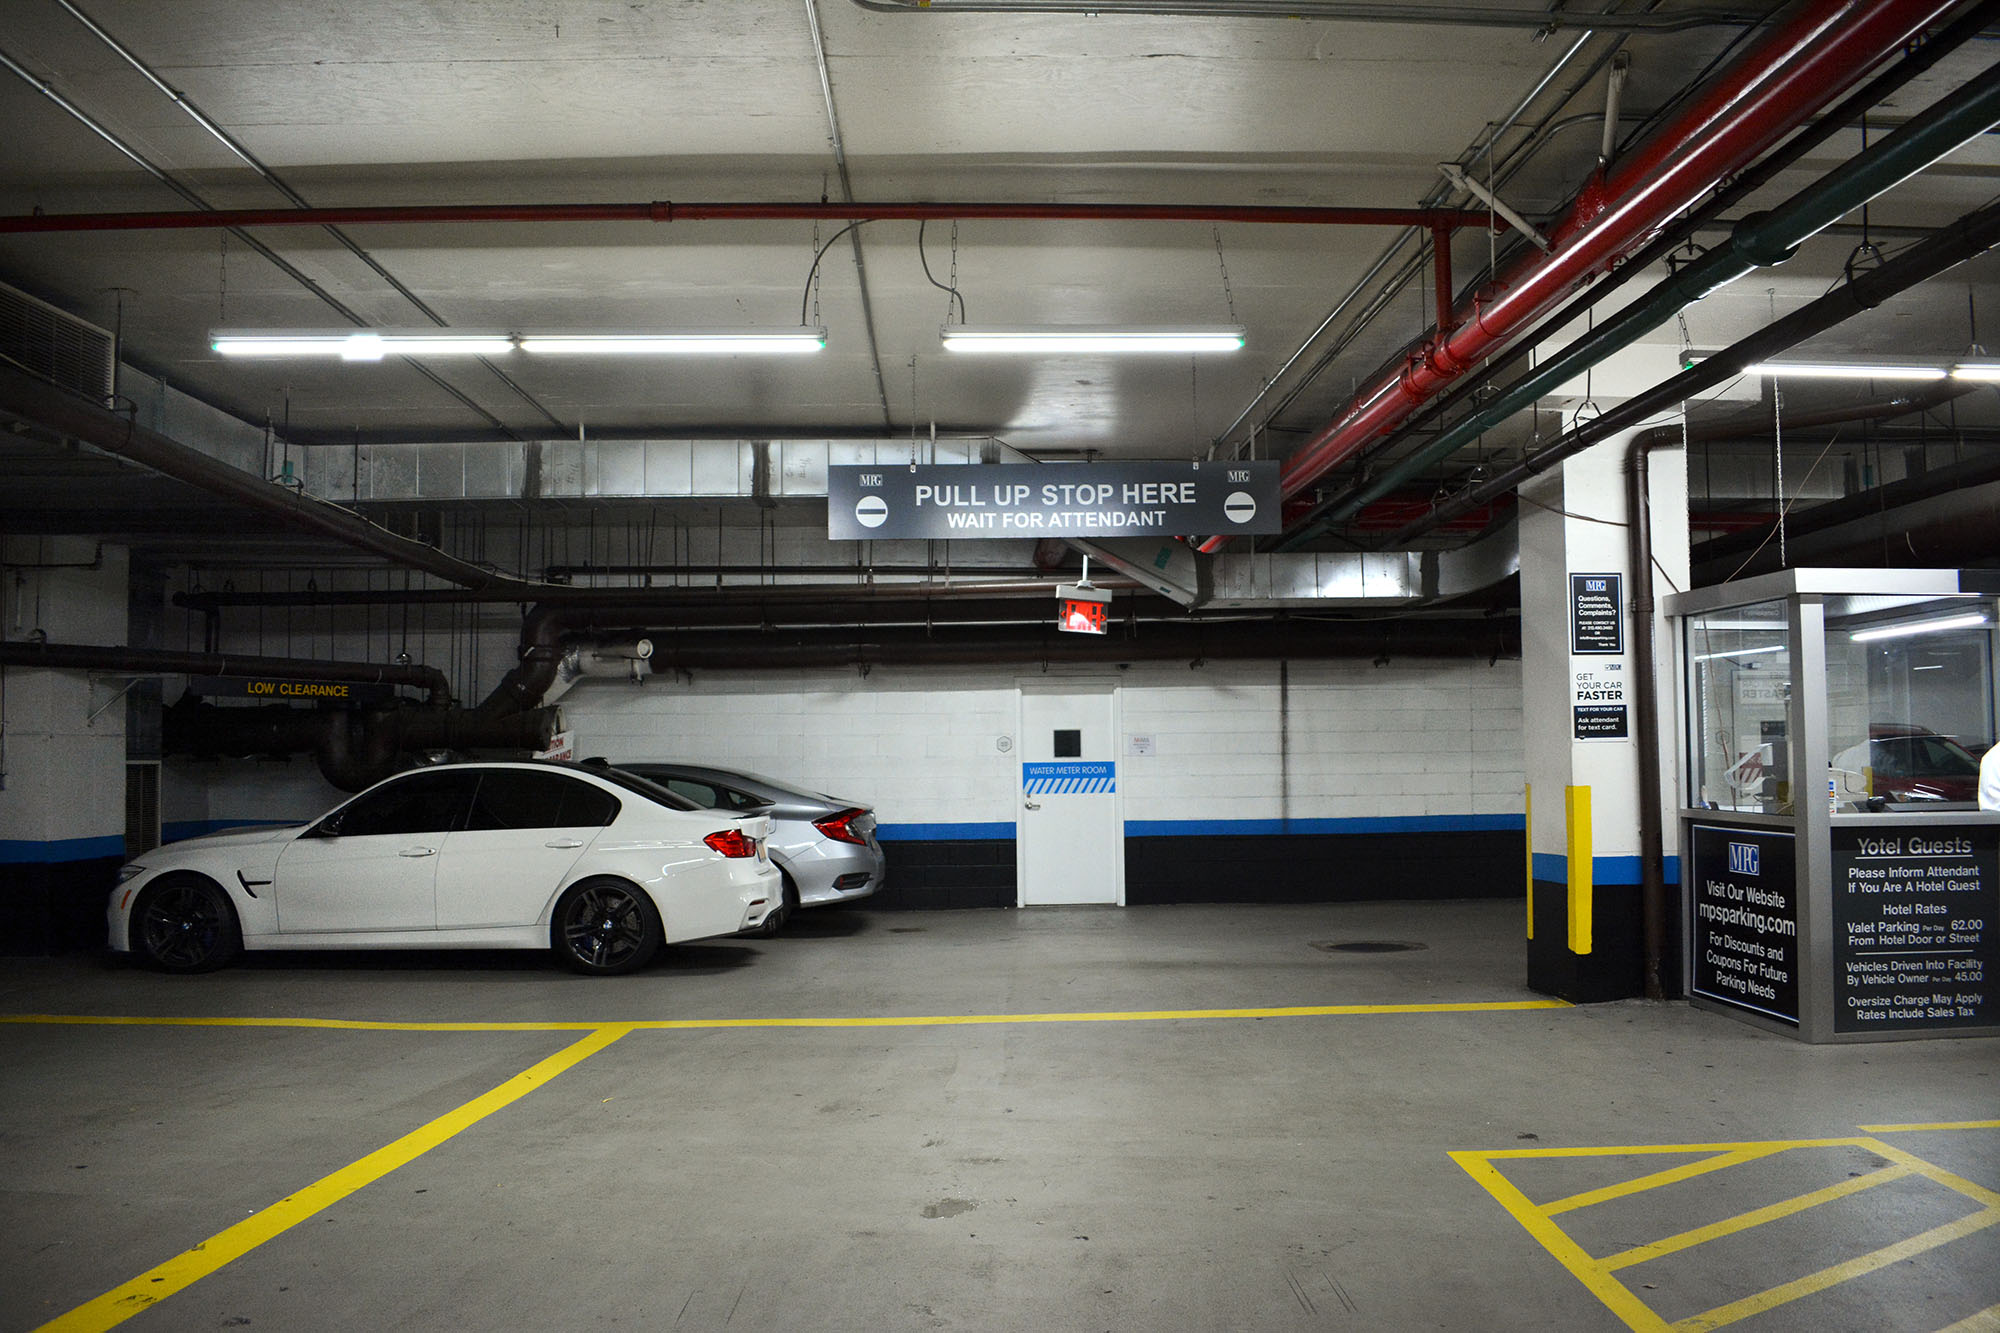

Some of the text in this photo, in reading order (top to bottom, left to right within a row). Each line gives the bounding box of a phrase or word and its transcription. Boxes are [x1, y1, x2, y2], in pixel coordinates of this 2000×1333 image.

[860, 474, 882, 486] MPG
[1228, 471, 1250, 482] MPG
[916, 482, 1197, 507] PULL UP STOP HERE
[947, 510, 1167, 529] WAIT FOR ATTENDANT
[1578, 609, 1616, 617] Complaints?
[1576, 673, 1593, 681] GET
[247, 681, 349, 698] LOW CLEARANCE
[1576, 681, 1622, 690] YOUR CAR
[1577, 690, 1623, 701] FASTER
[1029, 766, 1107, 775] WATER METER ROOM
[1857, 836, 1972, 855] Yotel Guests
[1730, 844, 1758, 874] MPG
[1848, 866, 1980, 879] Please Inform Attendant
[1848, 880, 1981, 893] If You Are A Hotel Guest
[1706, 880, 1786, 909] Visit Our Website
[1883, 903, 1948, 915] Hotel Rates
[1700, 902, 1796, 937] mpsparking.com
[1847, 922, 1876, 933] Valet
[1878, 921, 1920, 933] Parking
[1951, 919, 1983, 930] 62.00
[1709, 931, 1784, 962] For Discounts and
[1848, 933, 1980, 946] From Hotel Door or Street
[1706, 949, 1788, 983] Coupons For Future
[1846, 959, 1983, 972] Vehicles Driven Into Facility
[1716, 970, 1776, 1000] Parking Needs
[1847, 975, 1859, 986] By
[1862, 974, 1895, 985] Vehicle
[1898, 973, 1929, 984] Owner
[1954, 971, 1983, 981] 45.00
[1847, 993, 1983, 1007] Oversize Charge May Apply
[1857, 1006, 1975, 1020] Rates Include Sales Tax
